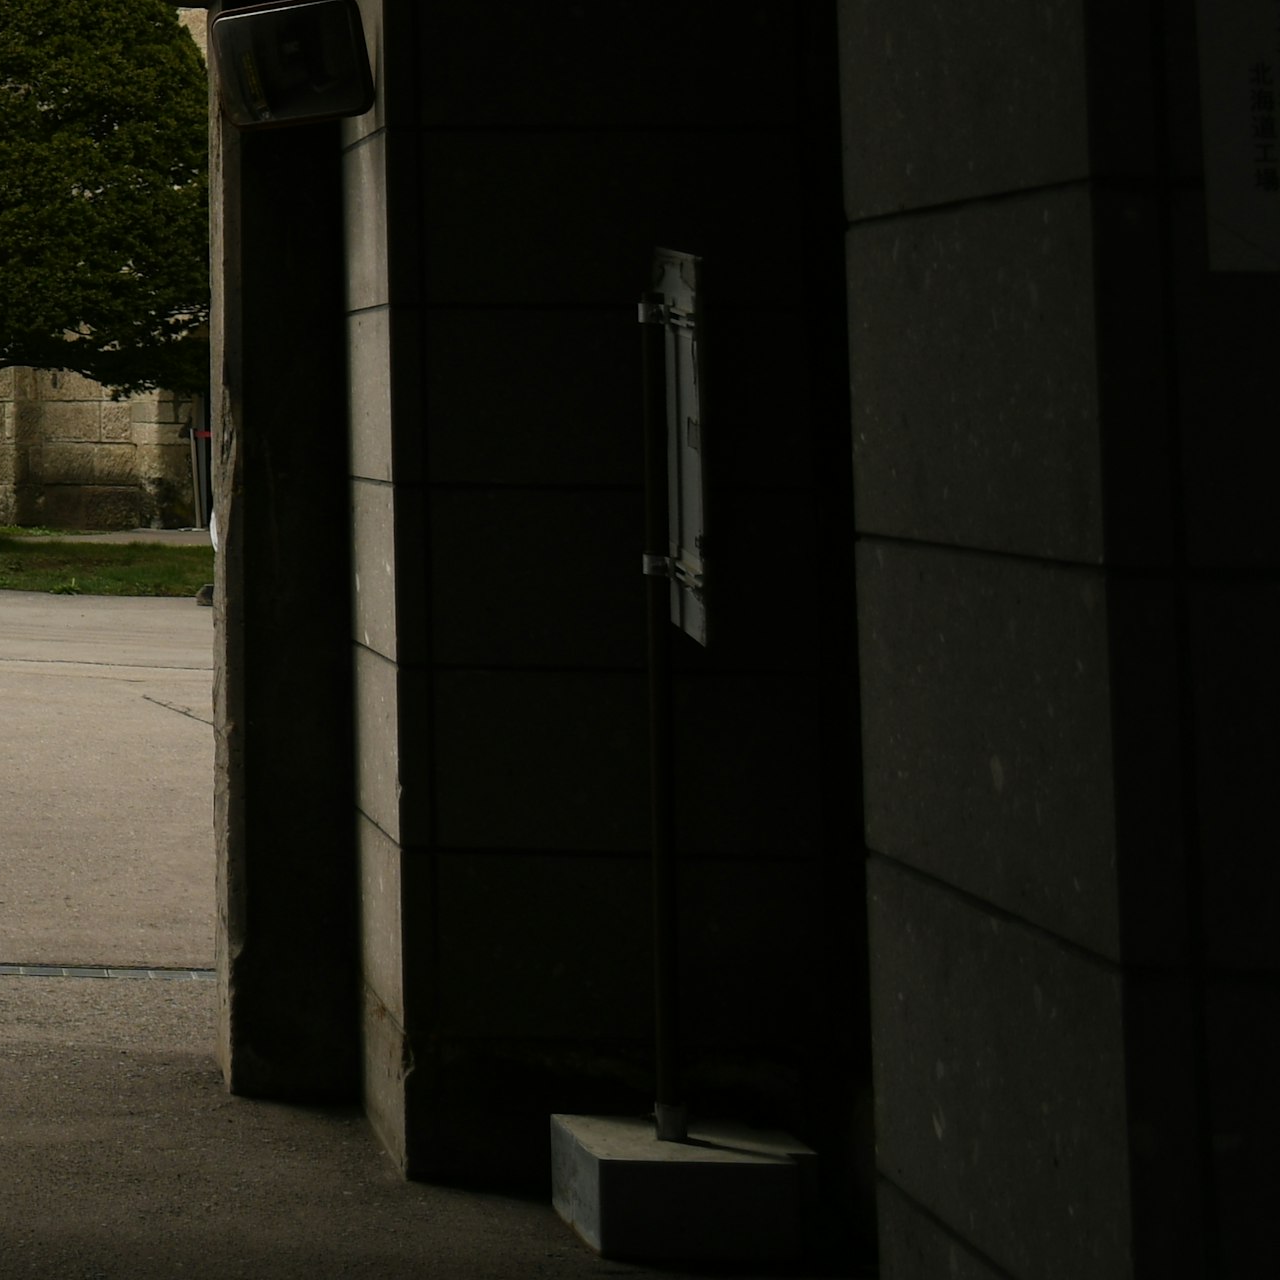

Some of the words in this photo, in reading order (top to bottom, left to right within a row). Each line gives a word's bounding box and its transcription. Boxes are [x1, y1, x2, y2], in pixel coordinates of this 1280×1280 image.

[1248, 63, 1279, 193] 北海道工場
